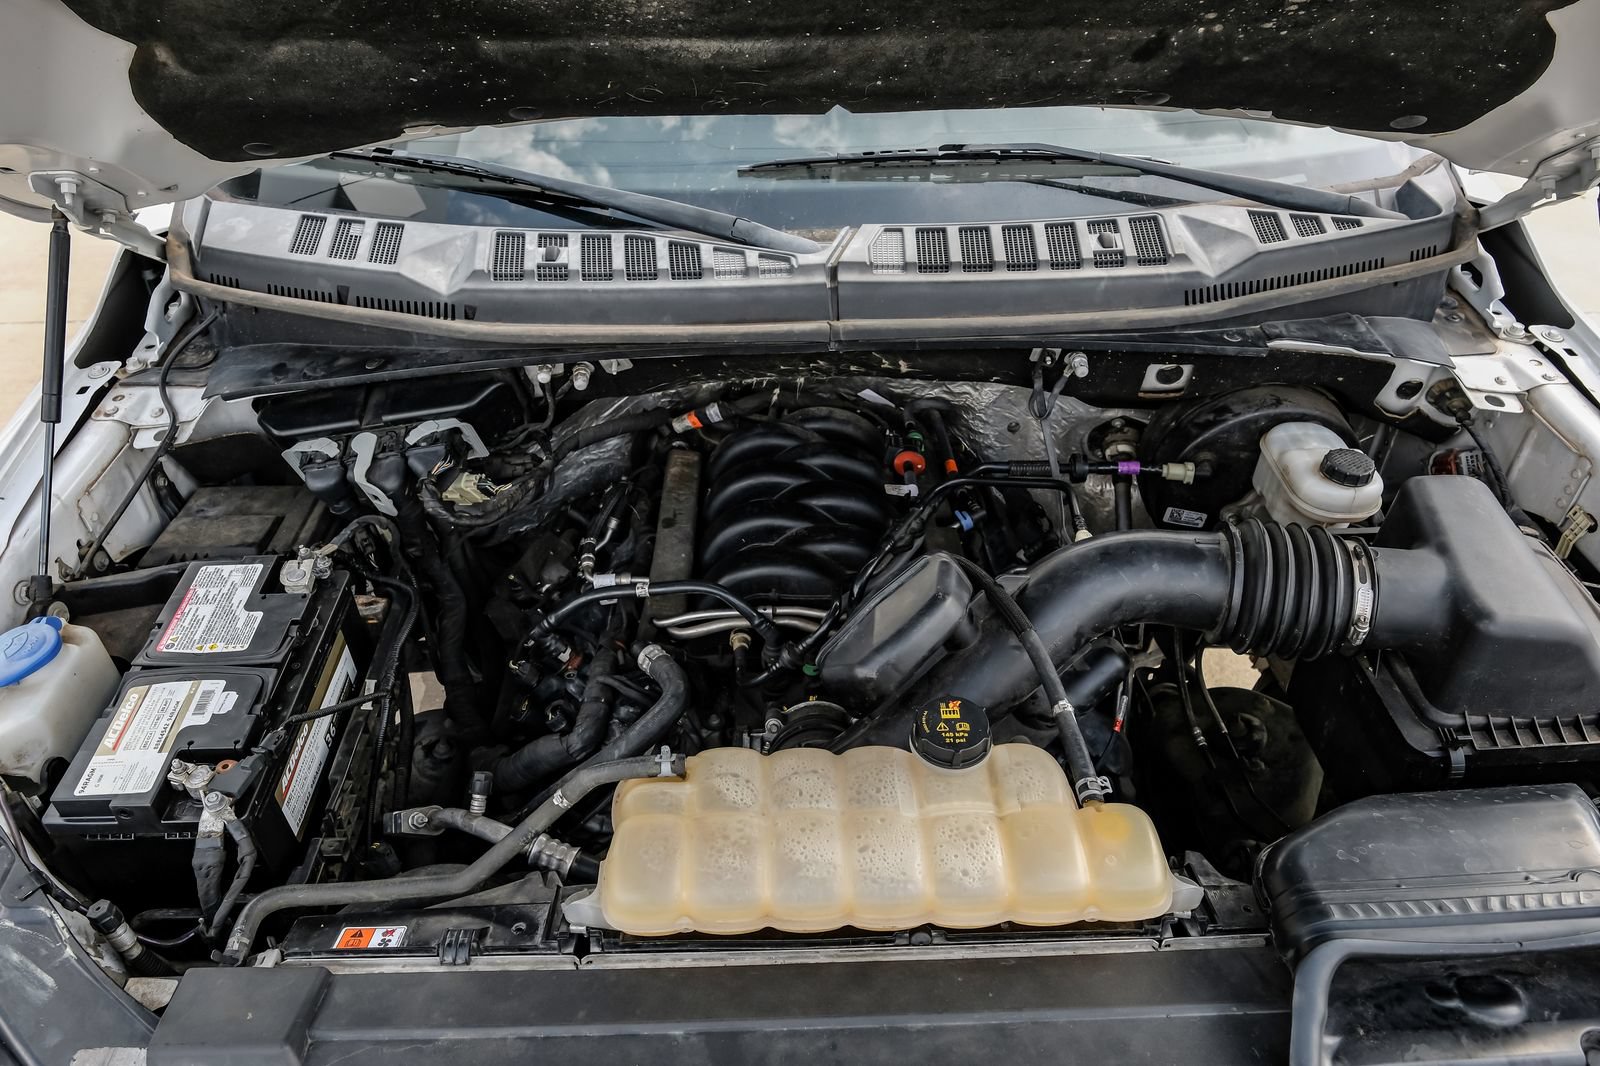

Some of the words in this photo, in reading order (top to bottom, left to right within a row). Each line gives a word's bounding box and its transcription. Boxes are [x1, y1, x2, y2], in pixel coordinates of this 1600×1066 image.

[103, 692, 140, 750] ACDelco
[167, 700, 181, 722] 94RAGM
[325, 722, 336, 748] 36
[281, 722, 309, 793] ACDelco
[78, 767, 97, 794] 94RAGM
